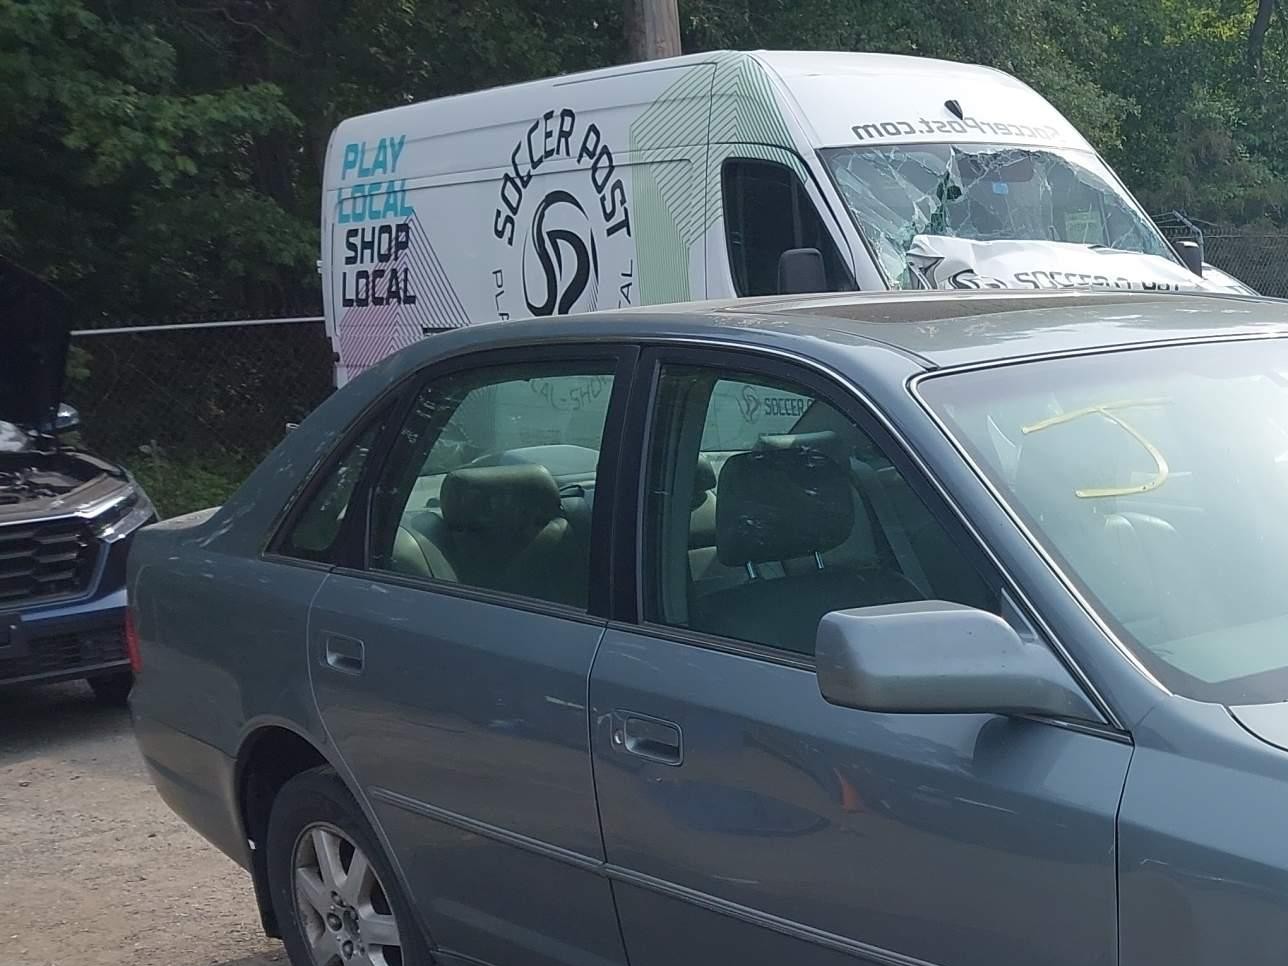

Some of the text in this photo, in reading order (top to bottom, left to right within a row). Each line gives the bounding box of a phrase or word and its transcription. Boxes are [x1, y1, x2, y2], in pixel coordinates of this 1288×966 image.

[342, 134, 407, 180] PLAY
[494, 108, 632, 247] SOCCER POST
[336, 178, 414, 224] LOCAL
[345, 223, 410, 266] SHOP
[342, 267, 417, 308] LOCAL
[764, 397, 806, 417] SOCCER
